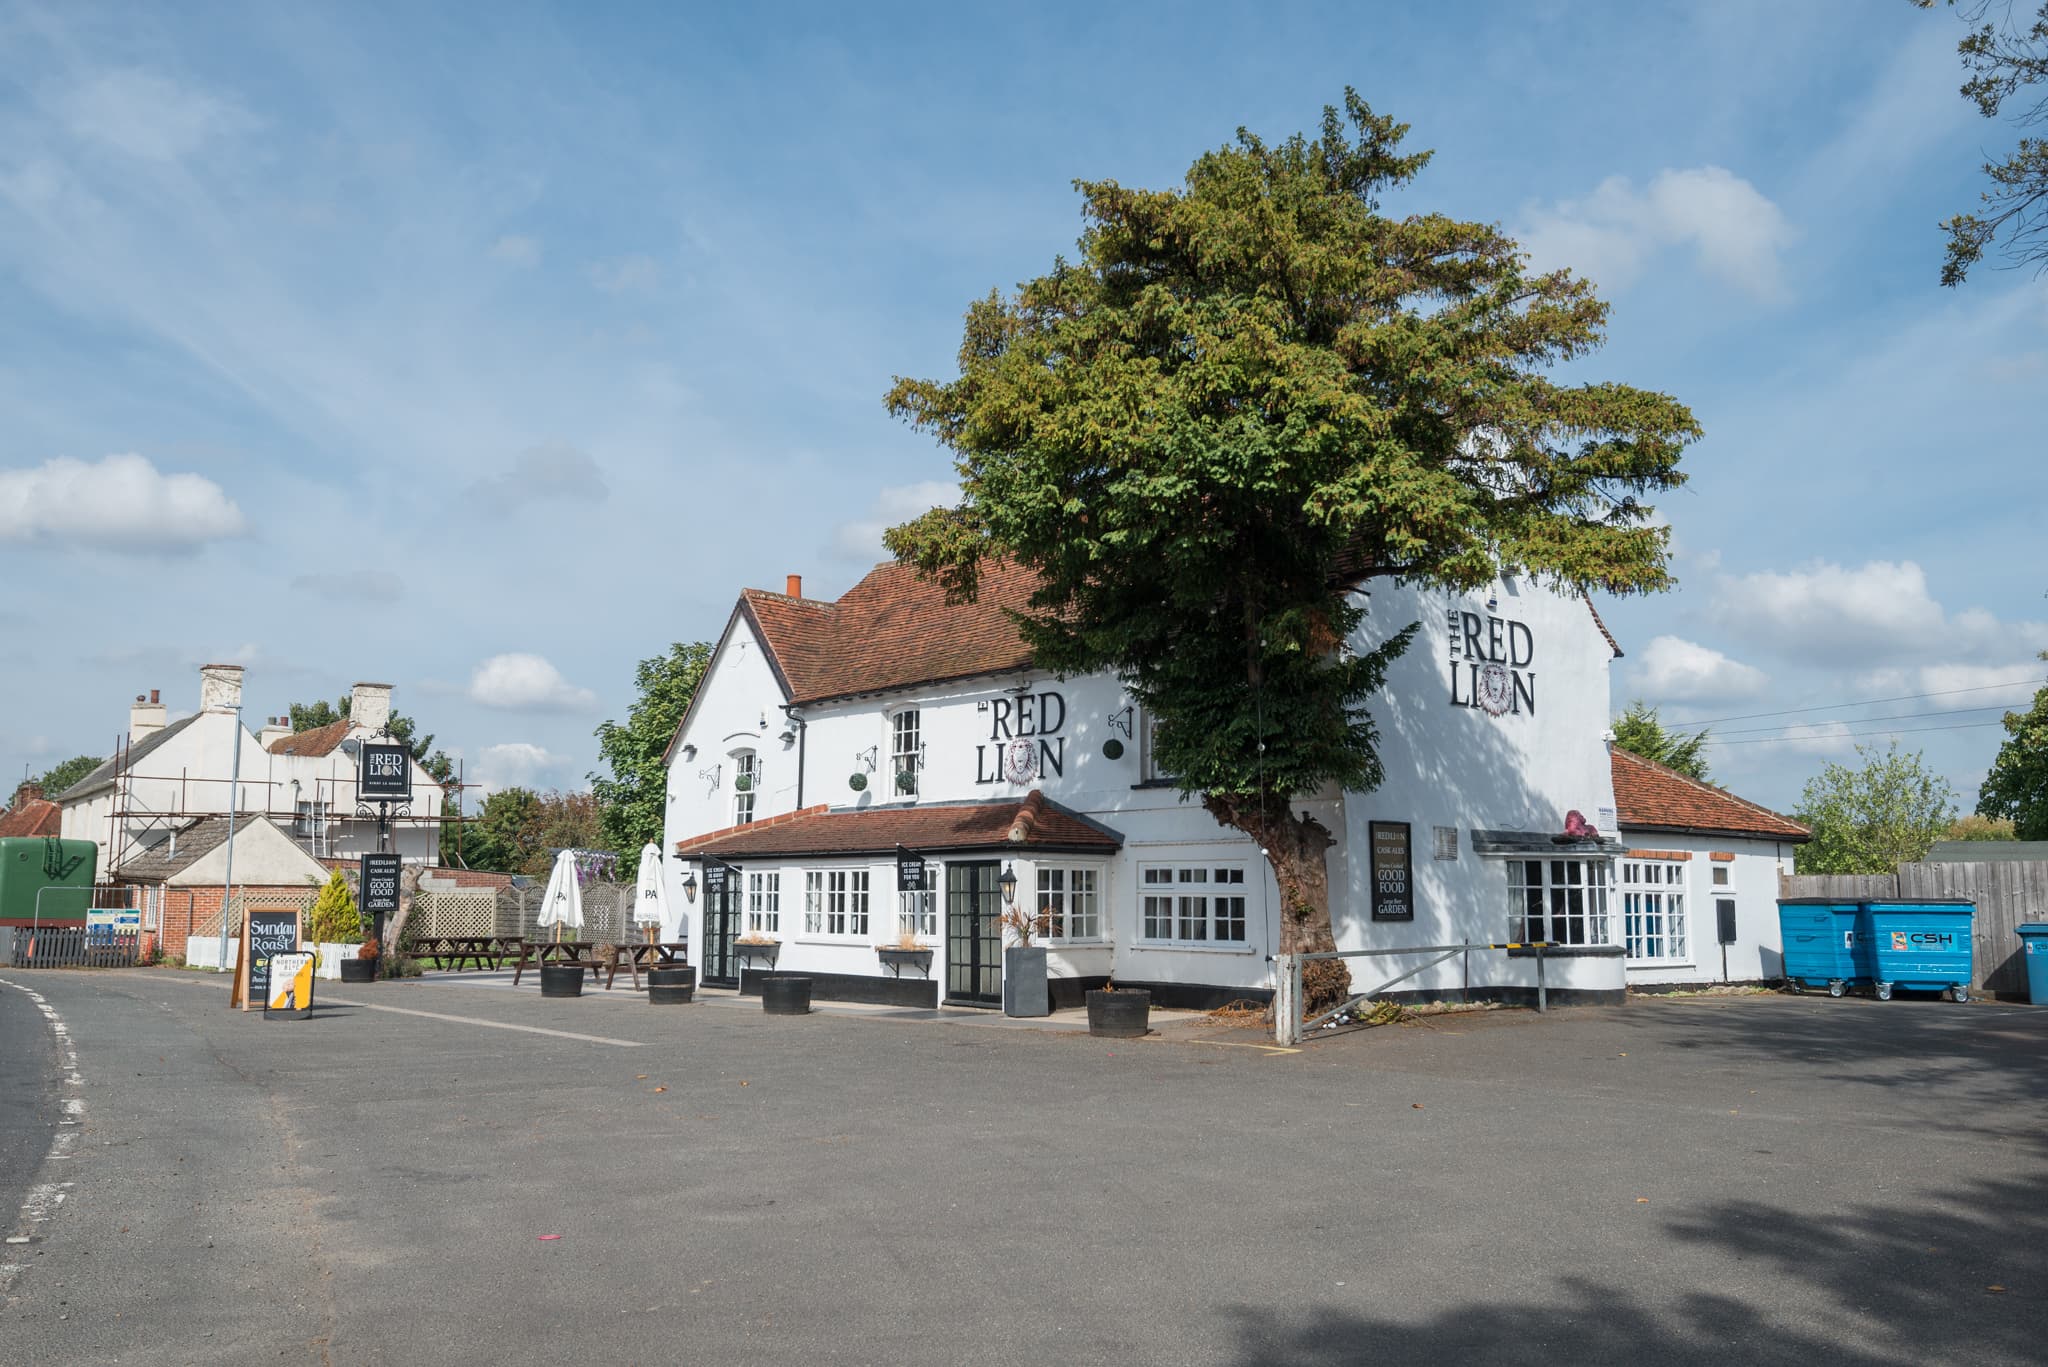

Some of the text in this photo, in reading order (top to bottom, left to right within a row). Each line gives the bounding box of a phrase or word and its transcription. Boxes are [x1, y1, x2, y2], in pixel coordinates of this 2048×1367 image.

[1447, 609, 1461, 658] THE
[1461, 611, 1533, 668] RED
[990, 692, 1065, 740] RED
[375, 753, 403, 766] RED
[1378, 869, 1405, 881] GOOD
[370, 888, 394, 896] FOOD
[1380, 882, 1405, 893] FOOD
[1378, 905, 1407, 914] GARDEN
[251, 920, 297, 943] Sunday
[251, 937, 289, 952] Roast
[1910, 933, 1953, 944] CSH
